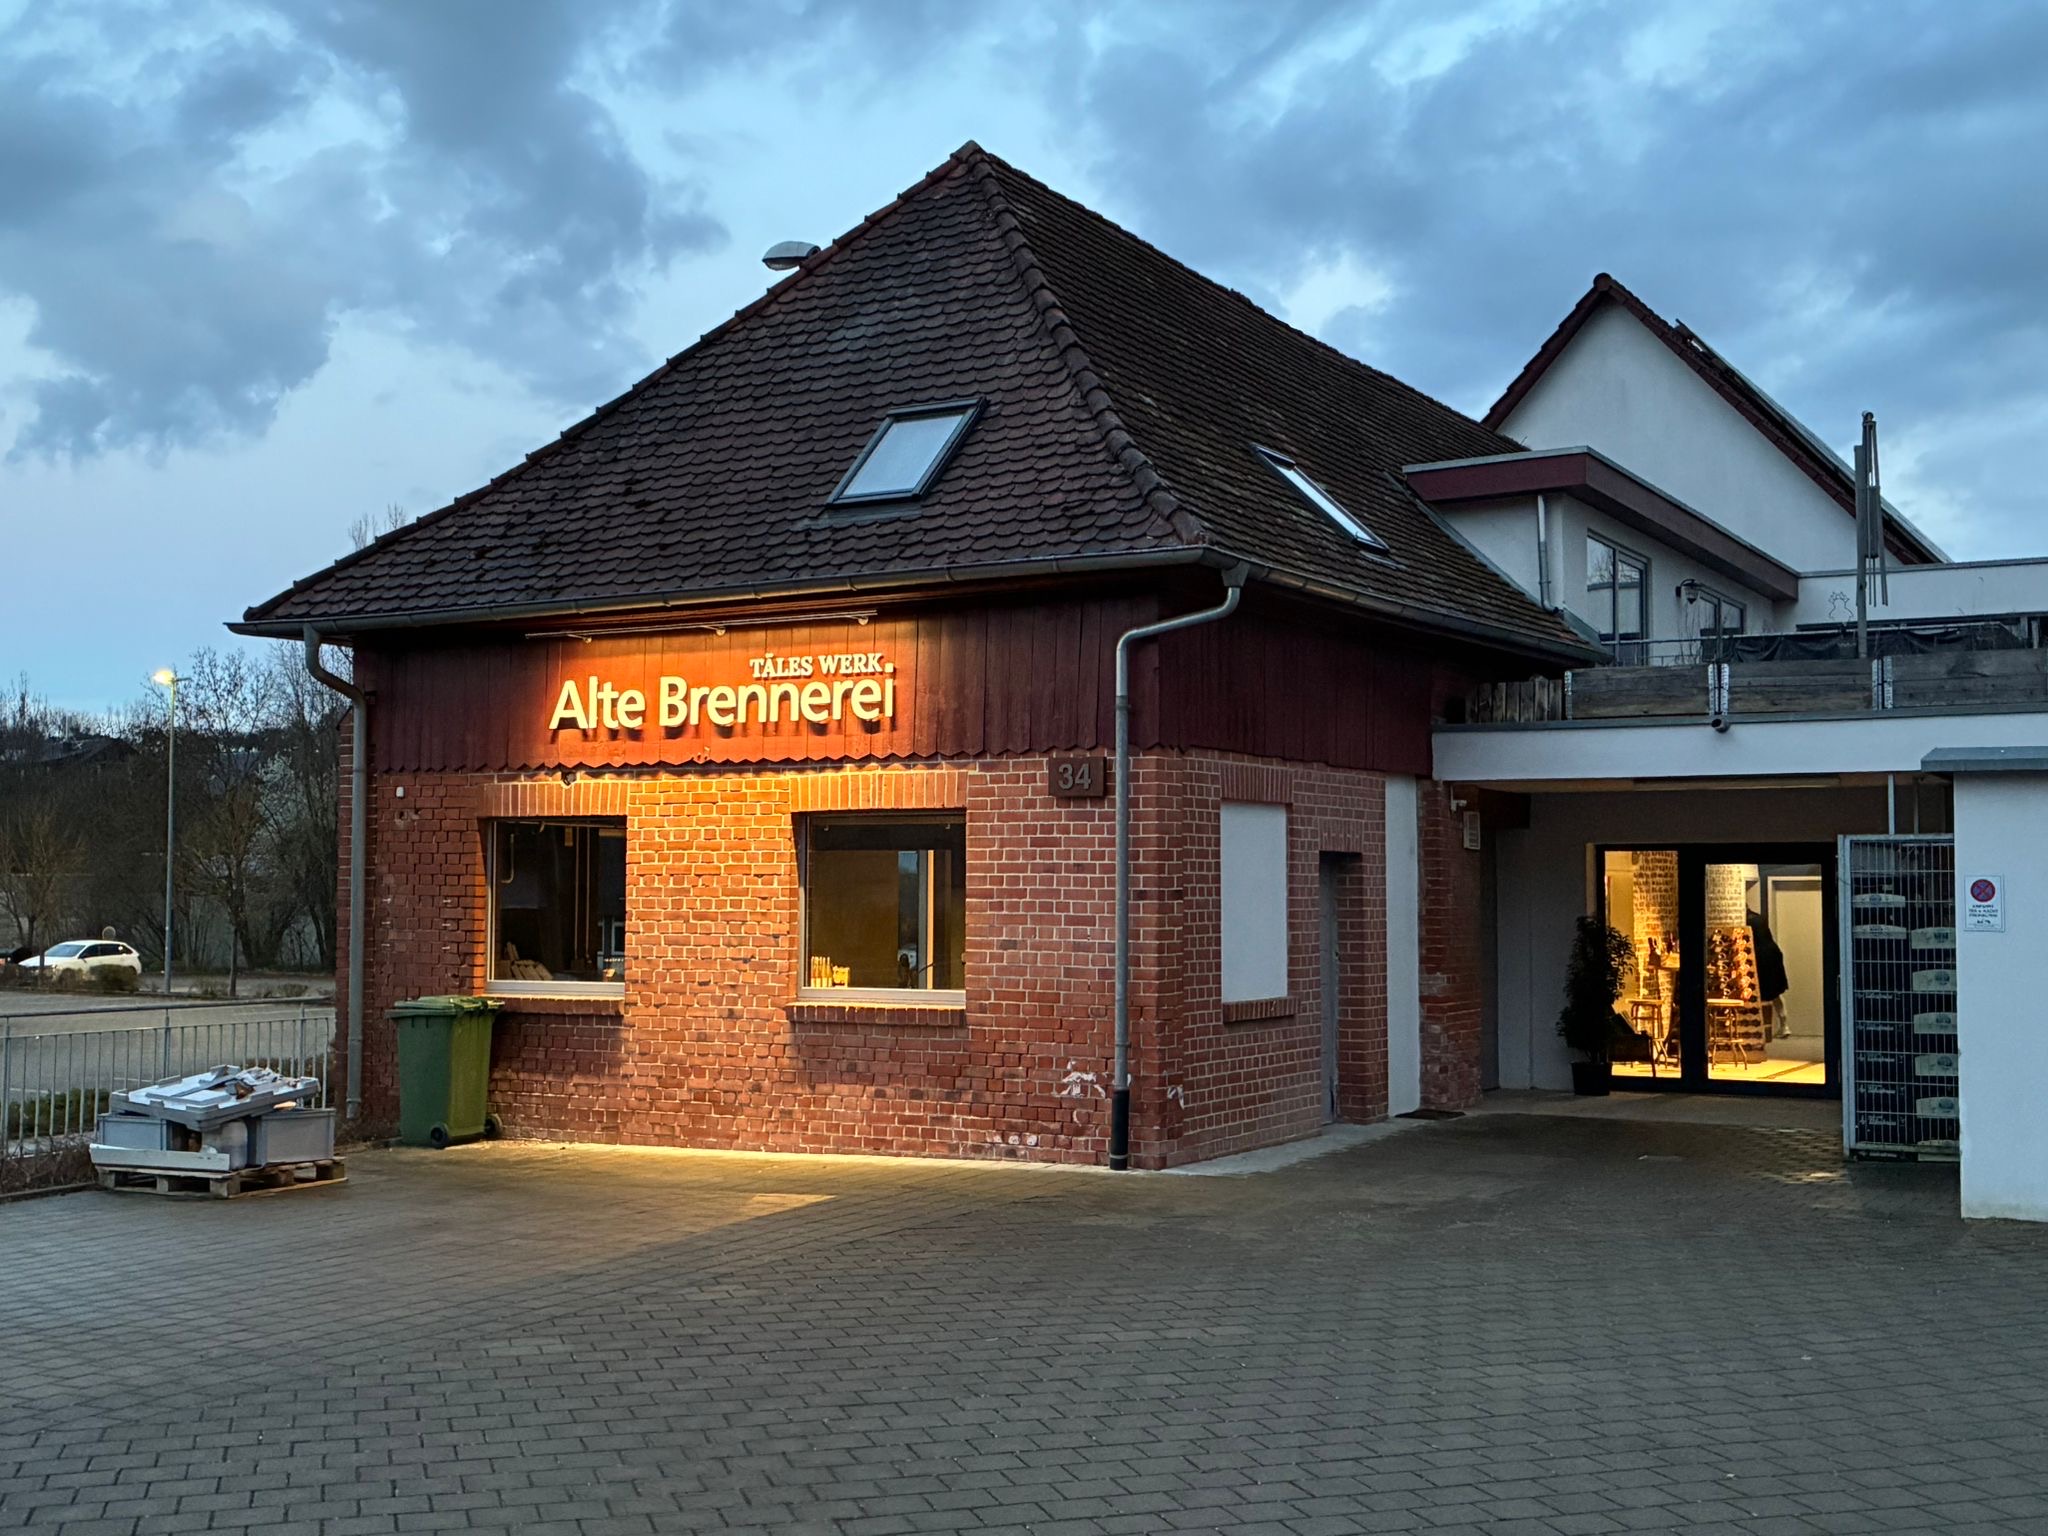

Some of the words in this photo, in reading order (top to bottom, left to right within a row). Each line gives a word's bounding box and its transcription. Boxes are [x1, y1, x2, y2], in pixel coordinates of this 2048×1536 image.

[549, 675, 646, 730] Alte
[658, 662, 894, 728] Brennerei
[1058, 763, 1092, 790] 34
